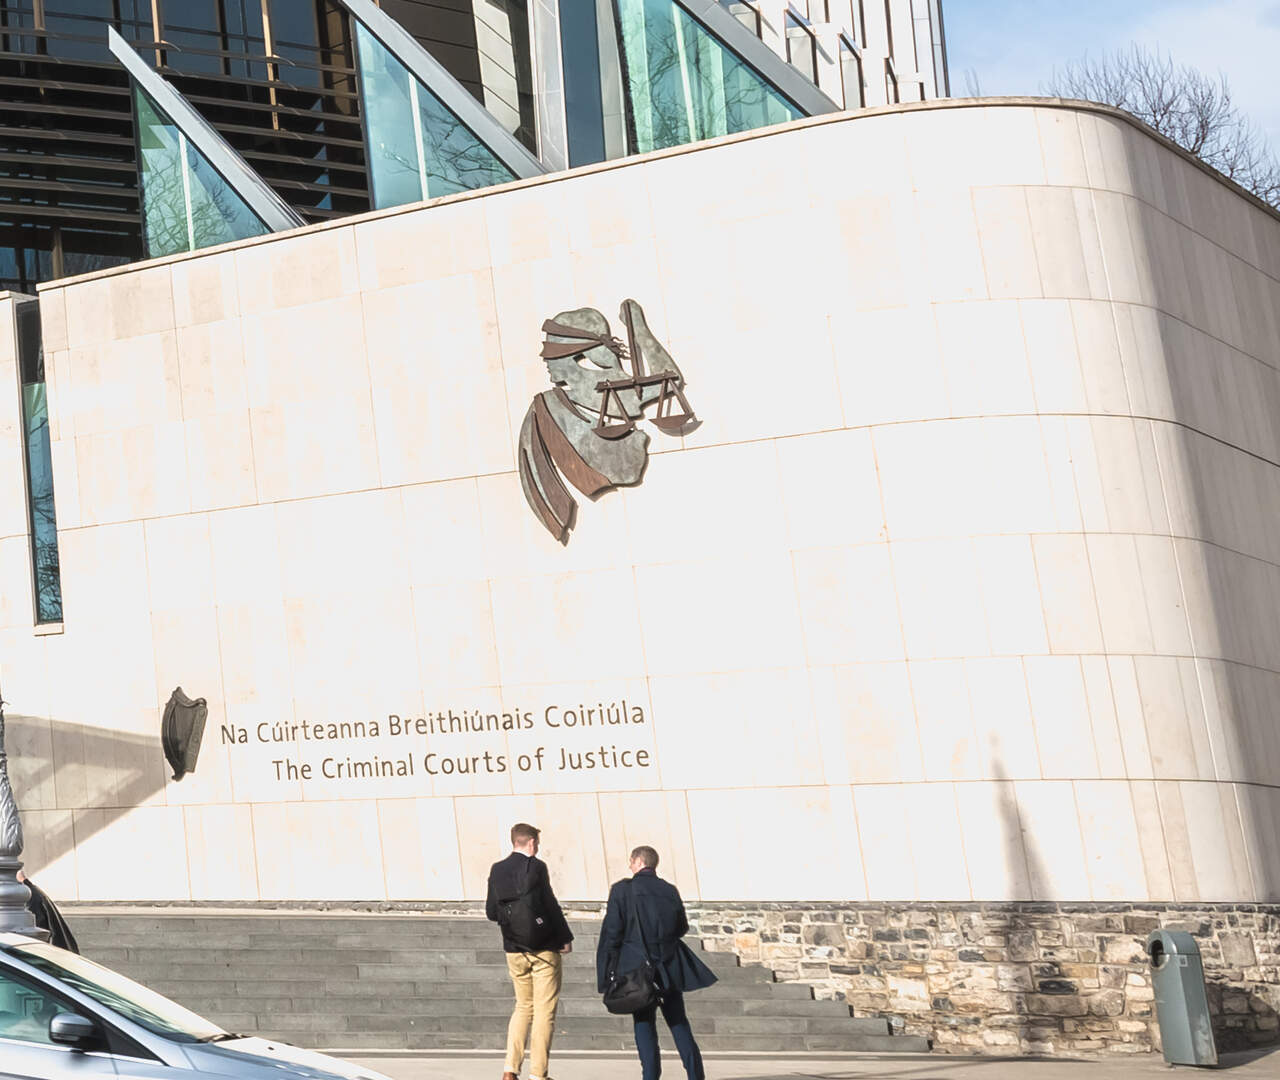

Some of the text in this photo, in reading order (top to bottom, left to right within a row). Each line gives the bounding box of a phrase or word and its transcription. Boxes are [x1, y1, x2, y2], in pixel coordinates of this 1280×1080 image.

[220, 700, 645, 745] Na Cúirteanna Breithiúnais Coiriúla
[272, 745, 649, 781] The Criminal Courts of Justice
